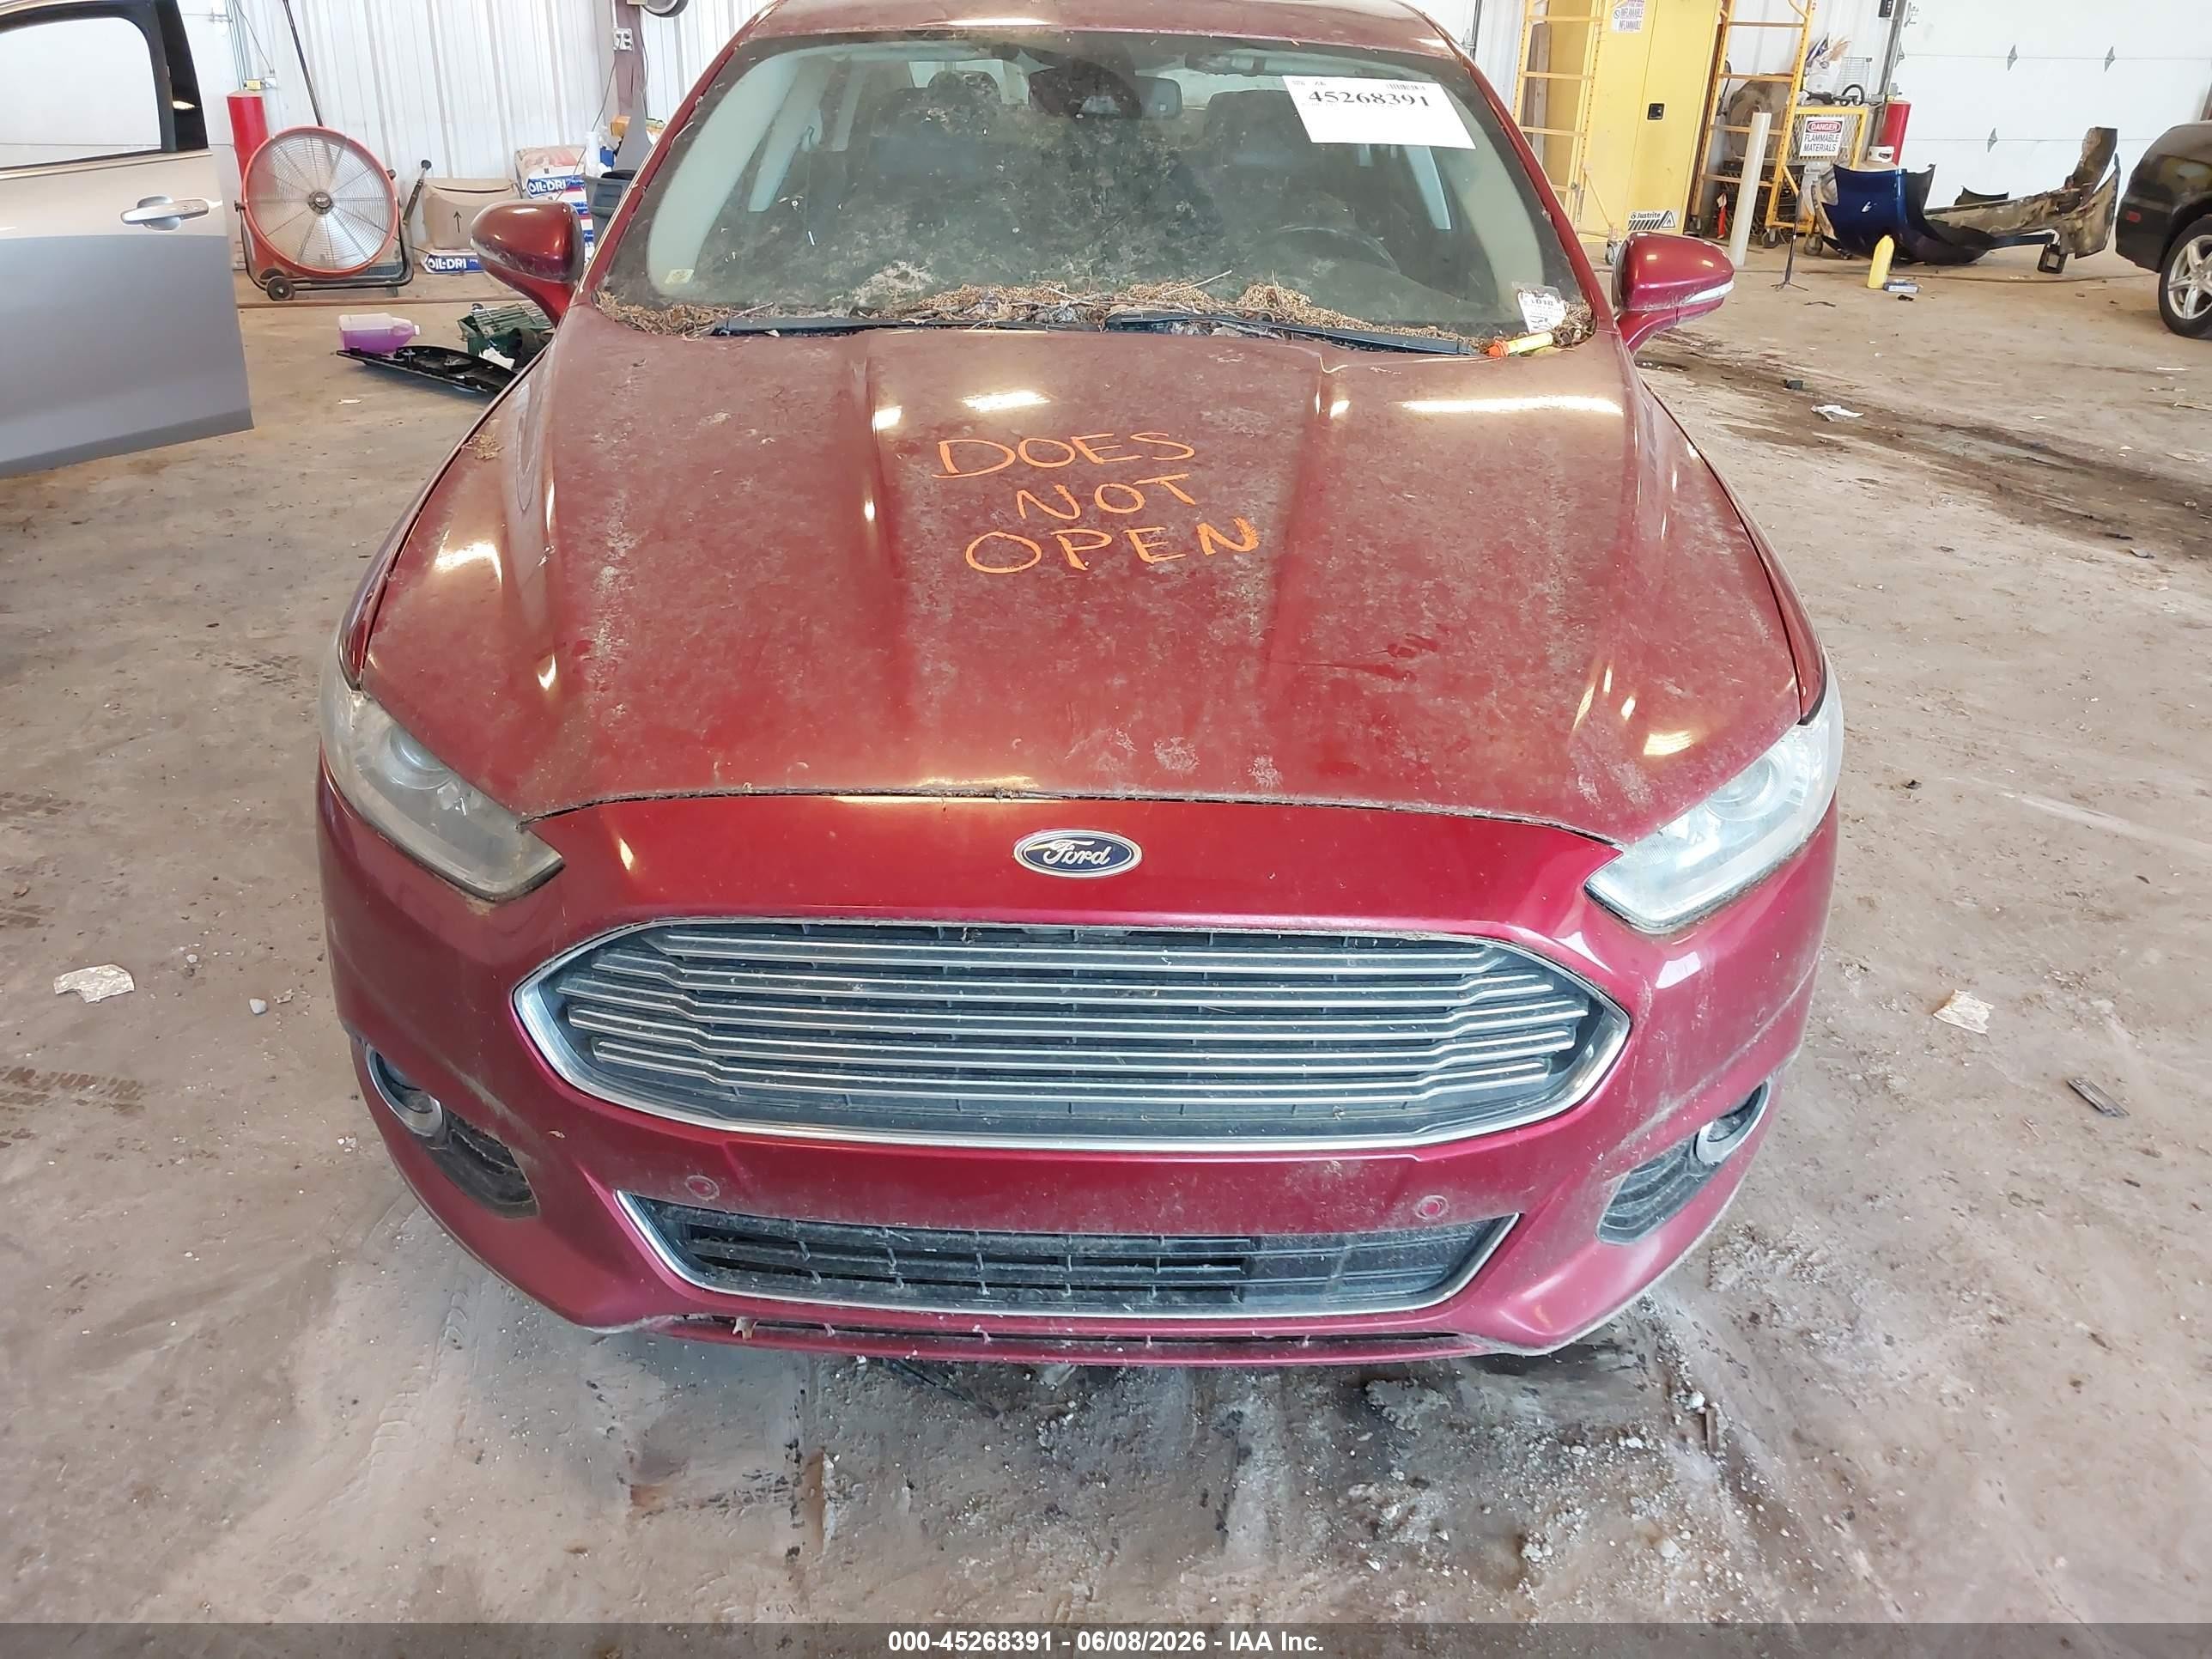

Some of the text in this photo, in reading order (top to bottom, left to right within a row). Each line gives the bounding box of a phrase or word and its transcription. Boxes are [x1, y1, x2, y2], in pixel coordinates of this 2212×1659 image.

[1309, 90, 1430, 106] 45268391
[1803, 143, 1837, 152] MATERIALS
[1804, 134, 1840, 143] FLAMMABLE
[932, 433, 1195, 478] DOES
[1017, 473, 1197, 520] NOT
[965, 516, 1261, 574] OPEN
